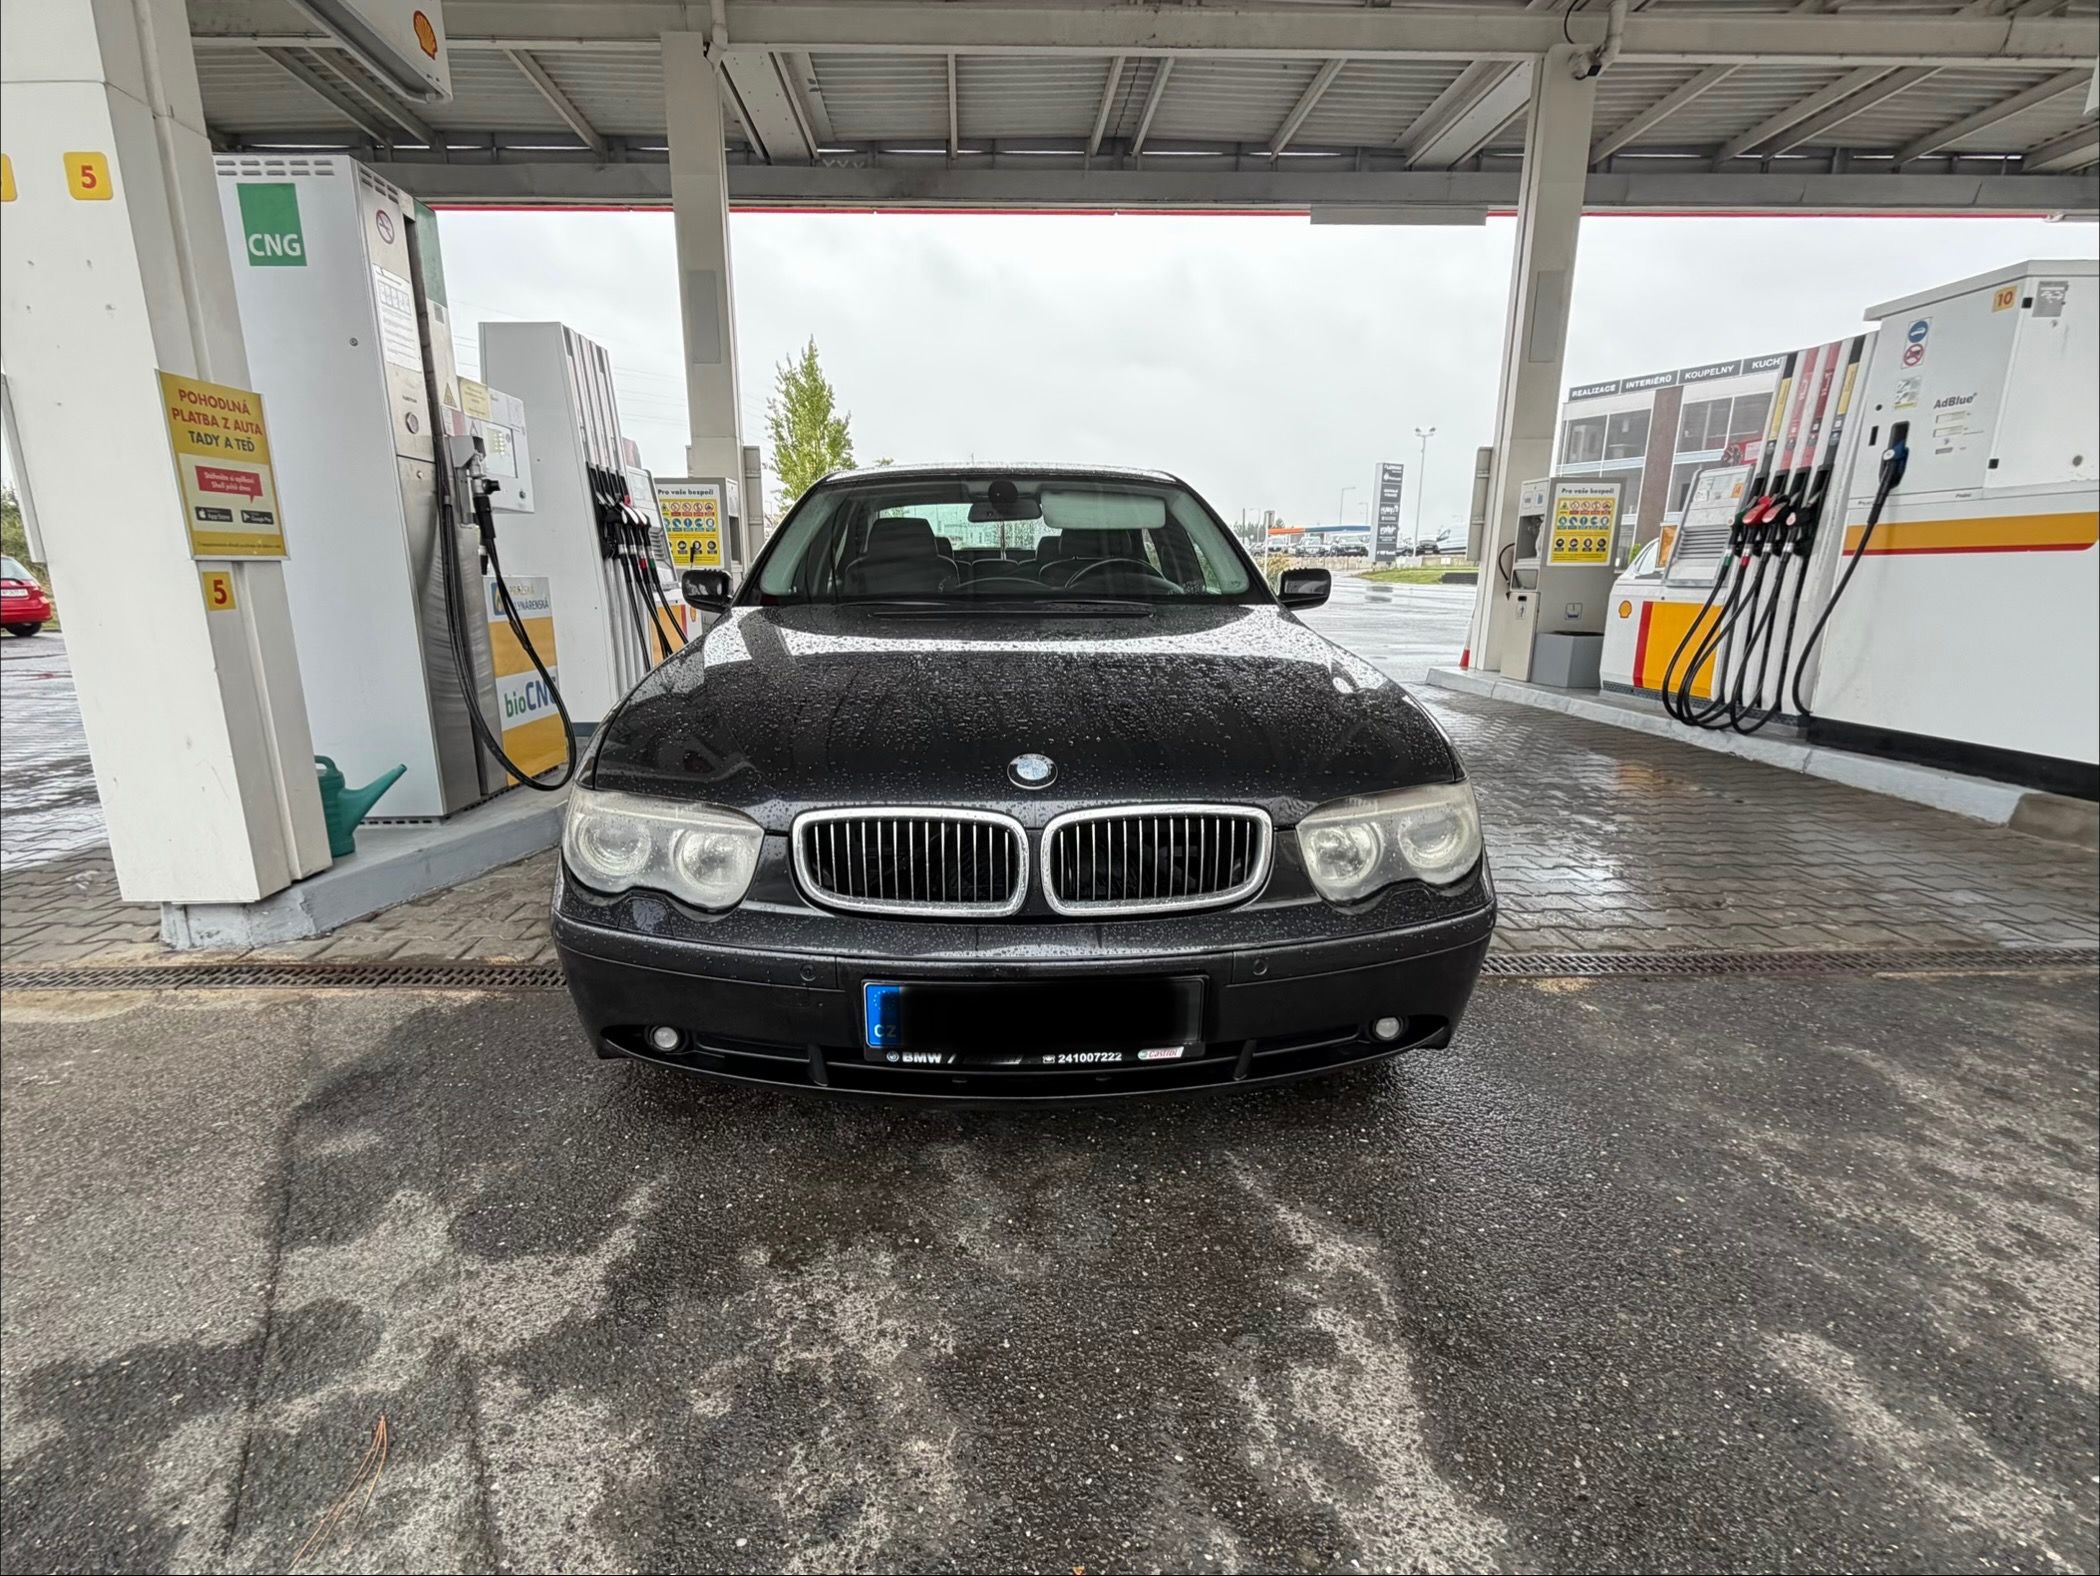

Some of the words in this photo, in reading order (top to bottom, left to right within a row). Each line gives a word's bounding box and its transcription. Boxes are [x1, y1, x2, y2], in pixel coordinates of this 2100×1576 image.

[81, 165, 97, 189] 5
[248, 233, 302, 257] CNG
[1997, 290, 2014, 307] 10
[1751, 357, 1781, 369] KUCH
[1684, 364, 1735, 381] KOUPELNY
[1571, 383, 1617, 398] REALIZACE
[178, 388, 251, 416] POHODLNÁ
[171, 407, 219, 428] PLATBA
[221, 416, 231, 430] Z
[234, 419, 263, 436] AUTA
[188, 430, 220, 447] TADY
[225, 436, 233, 449] A
[234, 436, 255, 452] TEĎ
[213, 579, 228, 605] 5
[513, 597, 549, 610] LYNÁRENSKÁ
[902, 1052, 942, 1064] BMW
[1058, 1052, 1122, 1063] 241007222
